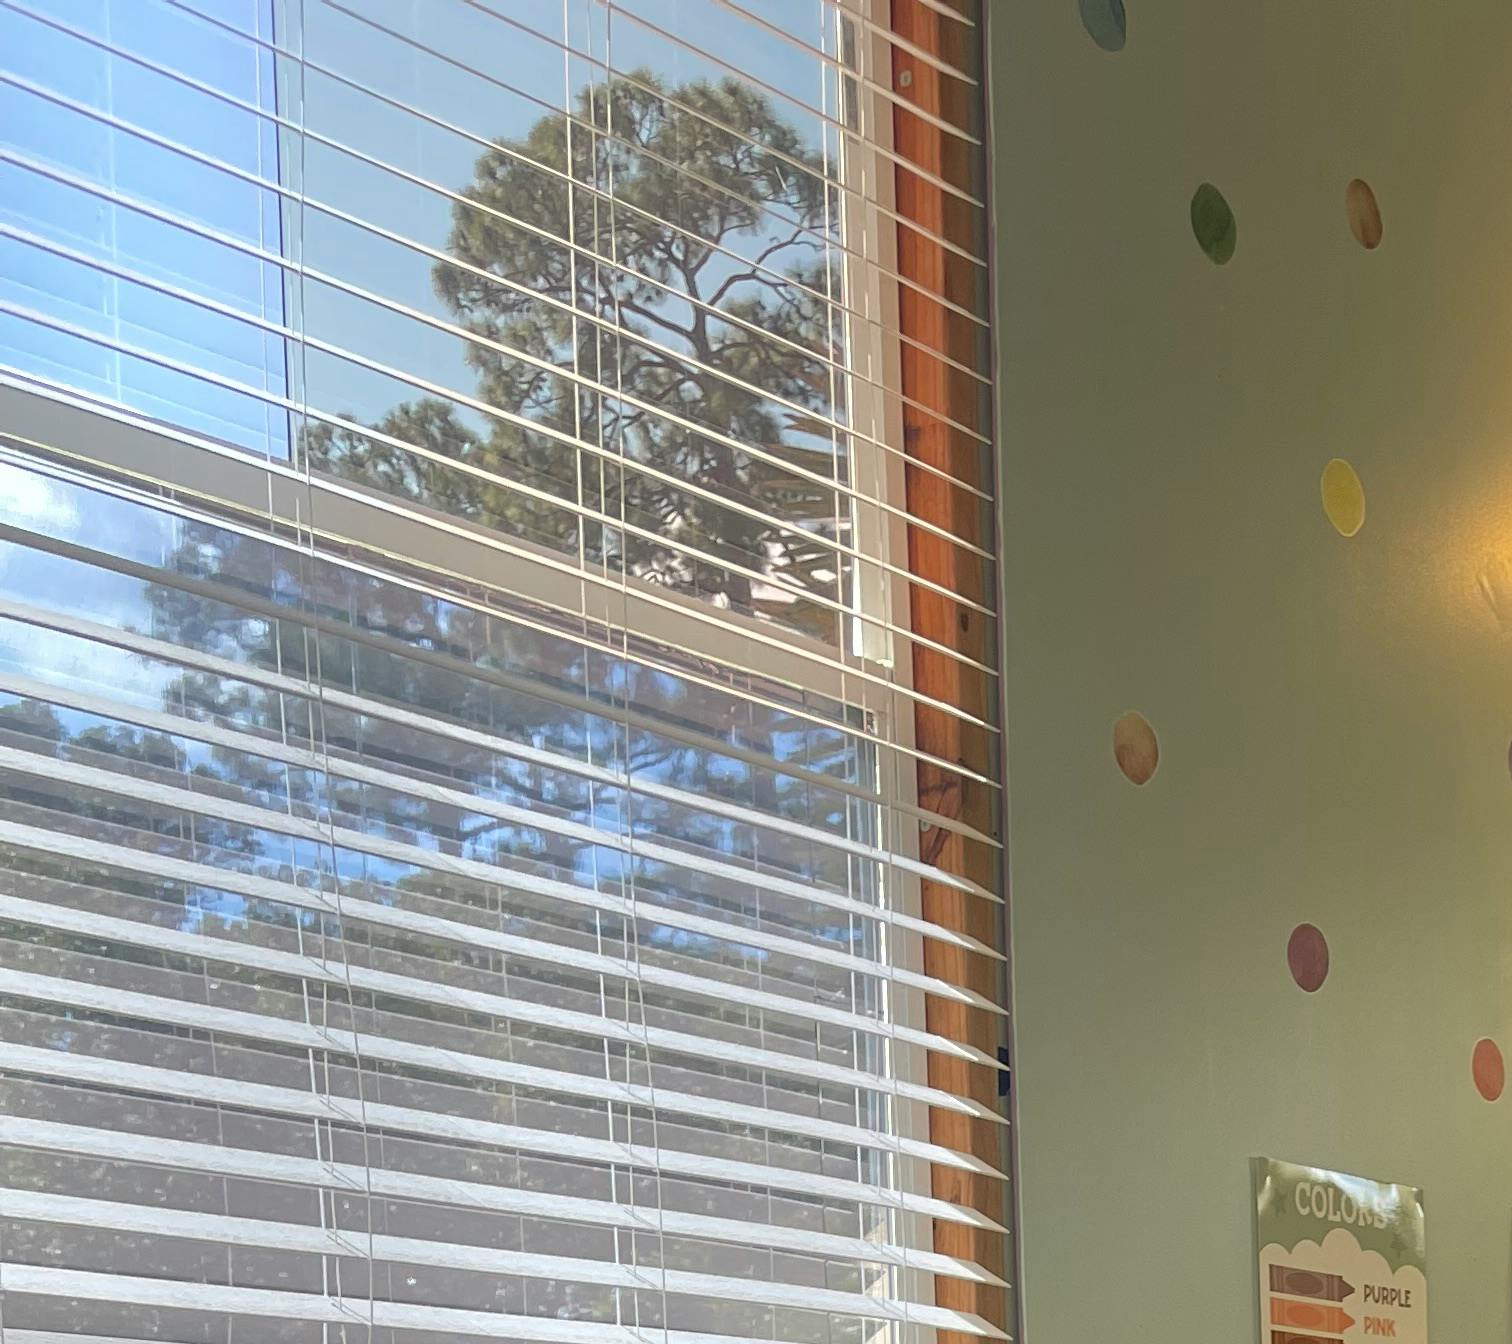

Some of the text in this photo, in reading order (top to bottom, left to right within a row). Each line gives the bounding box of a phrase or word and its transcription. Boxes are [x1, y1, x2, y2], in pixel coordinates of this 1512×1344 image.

[1295, 1181, 1390, 1230] COLORS
[1363, 1284, 1412, 1308] PURPLE
[1363, 1316, 1396, 1338] PINK
